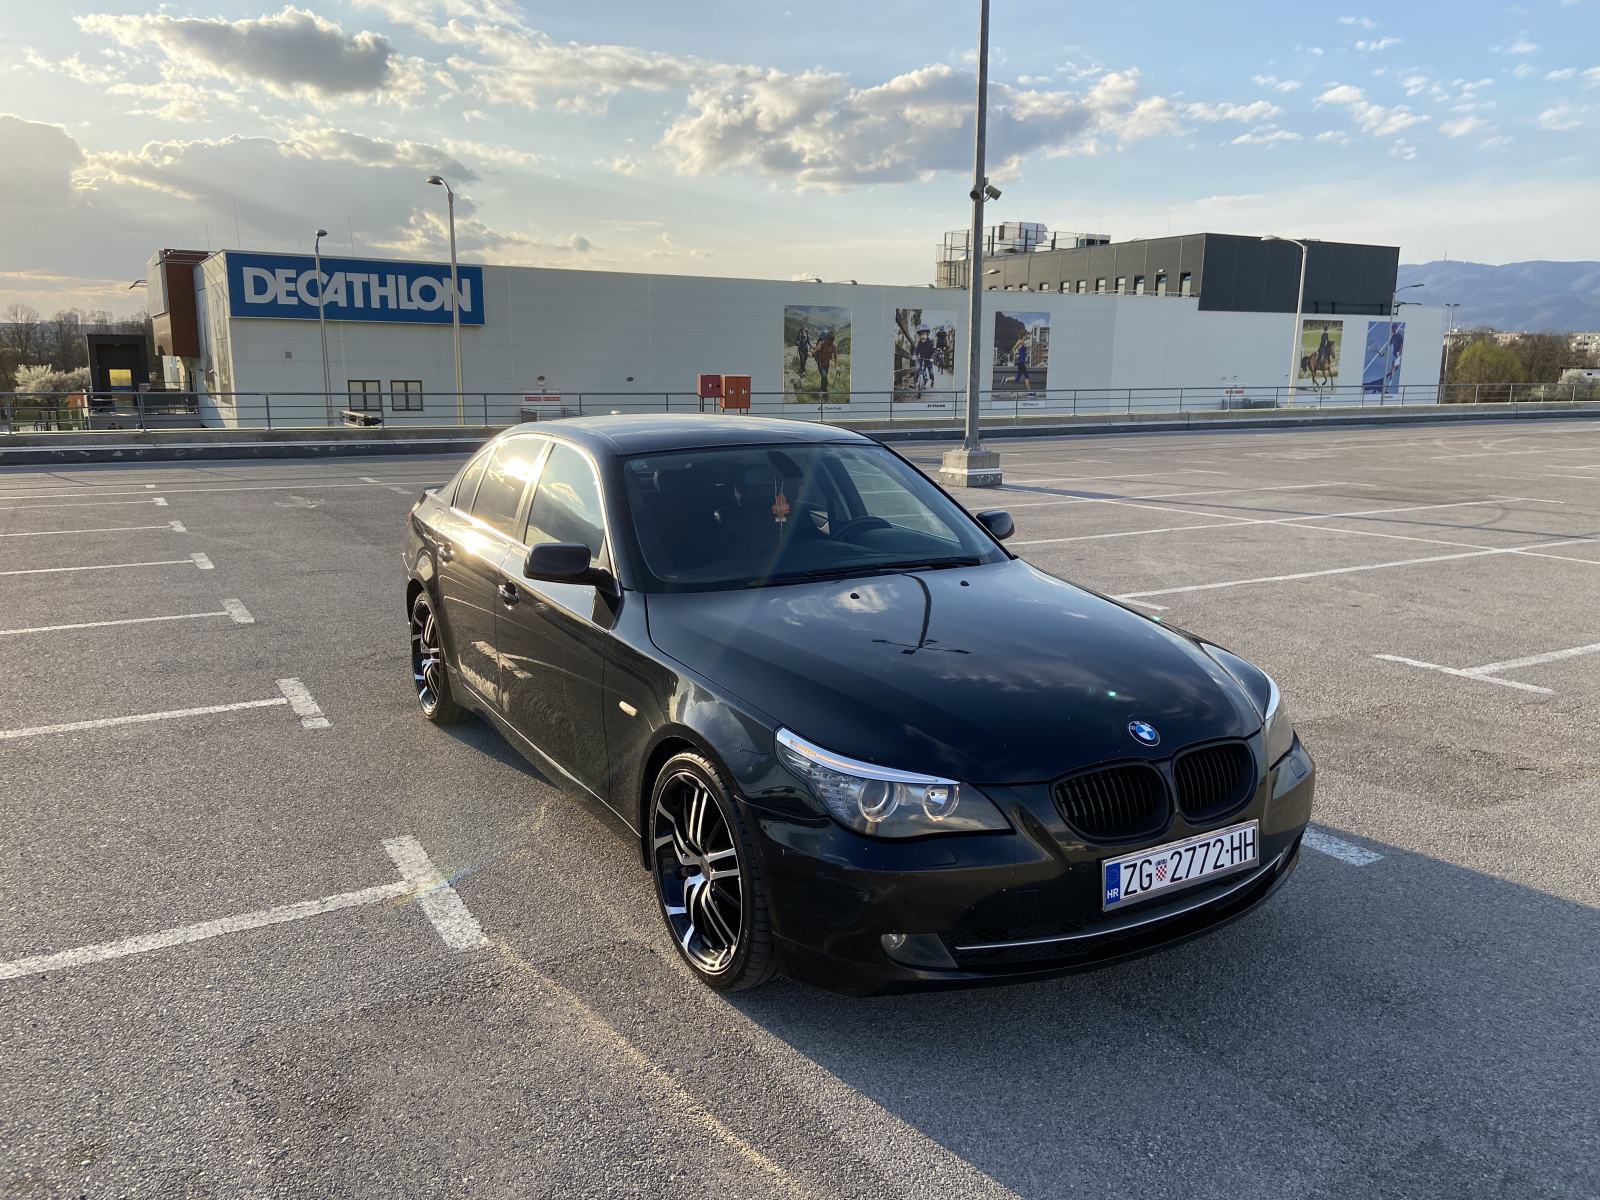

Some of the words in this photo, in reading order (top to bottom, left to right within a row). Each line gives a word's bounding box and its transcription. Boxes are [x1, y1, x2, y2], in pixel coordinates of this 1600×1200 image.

[242, 266, 471, 312] DECATHLON
[1106, 887, 1119, 900] HR
[1123, 859, 1153, 897] ZG
